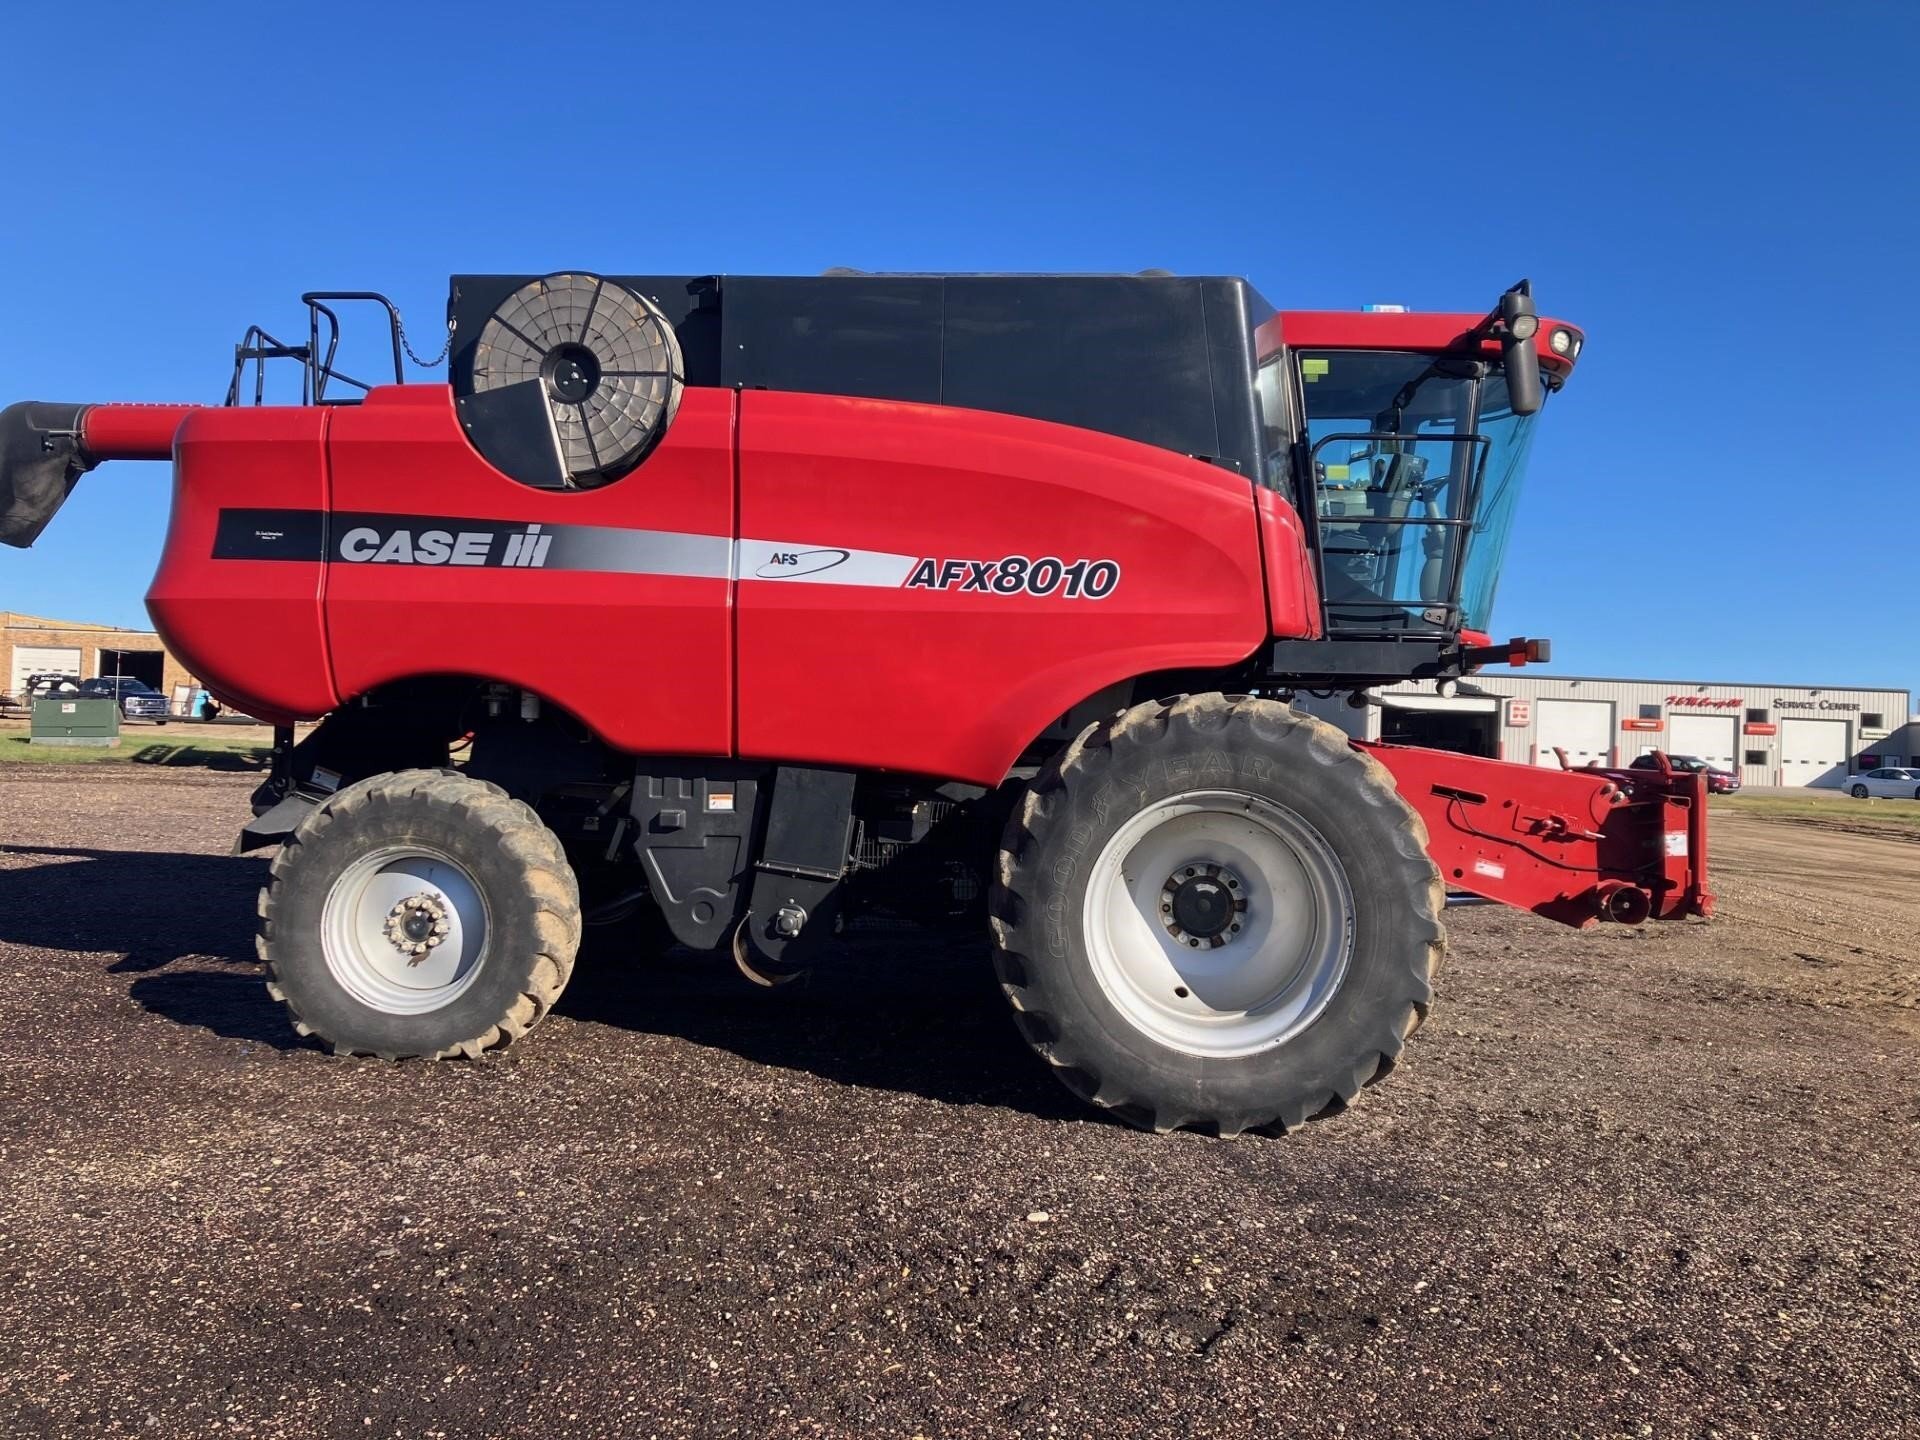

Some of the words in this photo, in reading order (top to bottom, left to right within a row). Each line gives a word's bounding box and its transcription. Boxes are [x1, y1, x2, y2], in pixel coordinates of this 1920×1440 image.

[340, 527, 494, 565] CASE
[770, 552, 798, 566] AFS
[905, 556, 1119, 599] AFX8010
[1046, 751, 1273, 958] GOODYEAR
